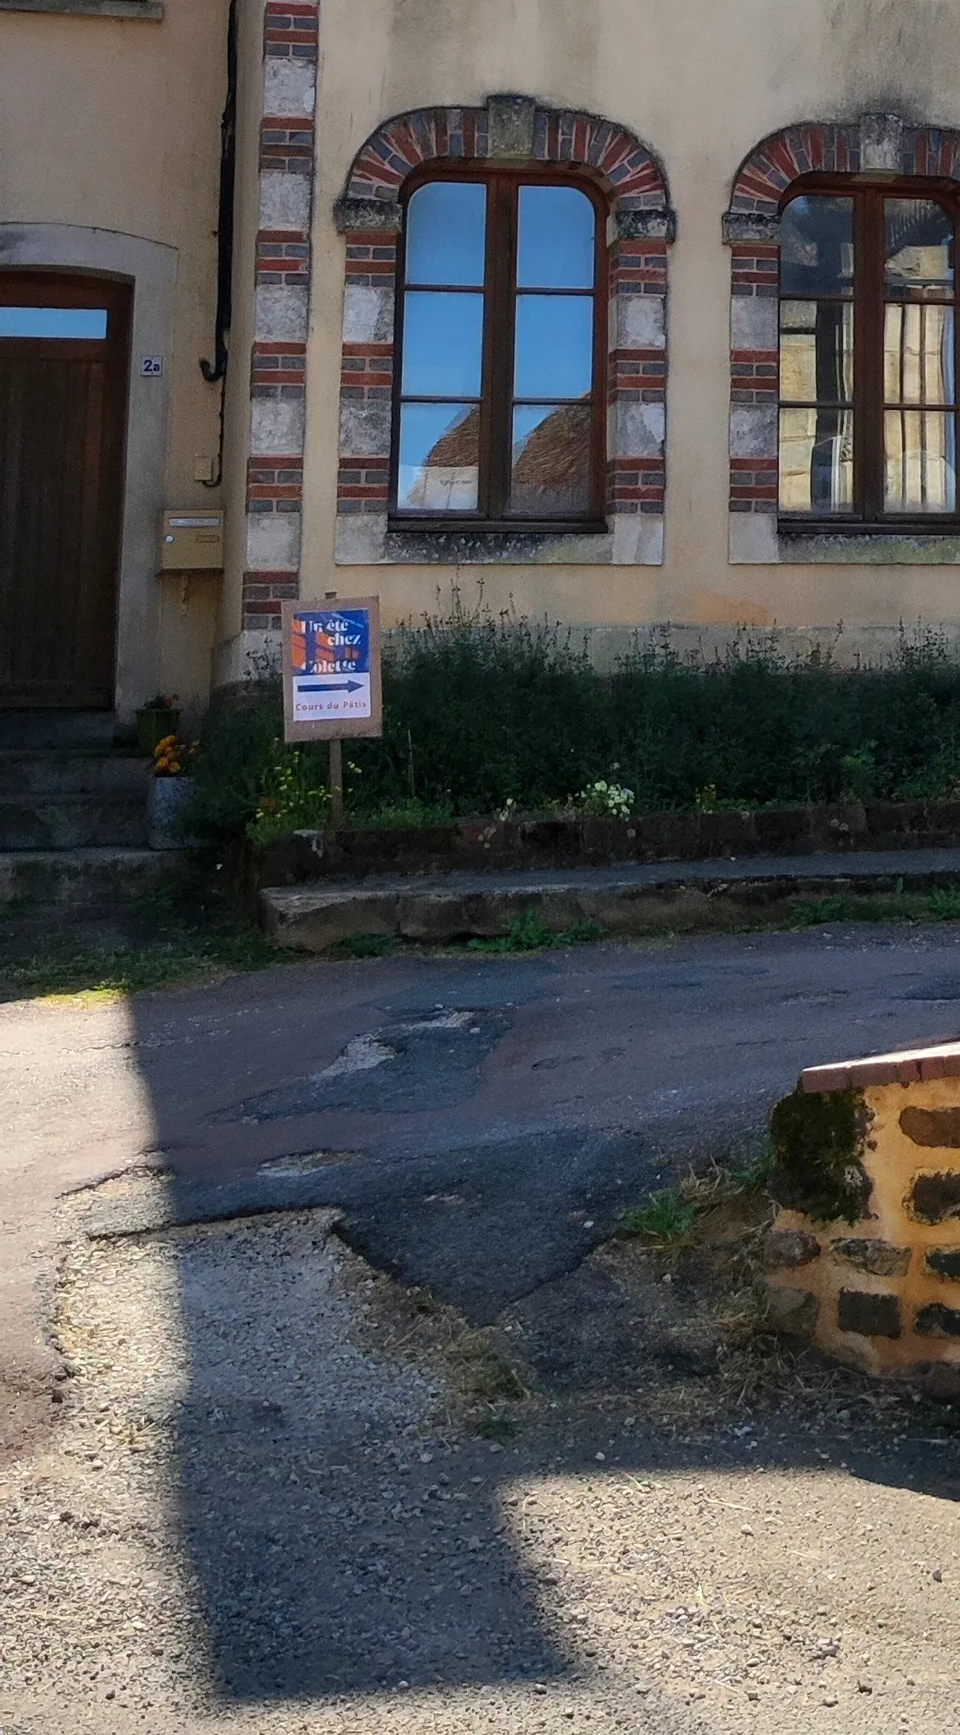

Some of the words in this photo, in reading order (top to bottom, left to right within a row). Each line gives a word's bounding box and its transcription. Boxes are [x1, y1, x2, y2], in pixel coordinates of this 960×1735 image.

[143, 359, 160, 372] 2a
[326, 618, 349, 633] été
[327, 632, 362, 647] chez
[300, 658, 357, 674] Colette
[295, 703, 323, 712] Cours
[326, 701, 339, 710] du
